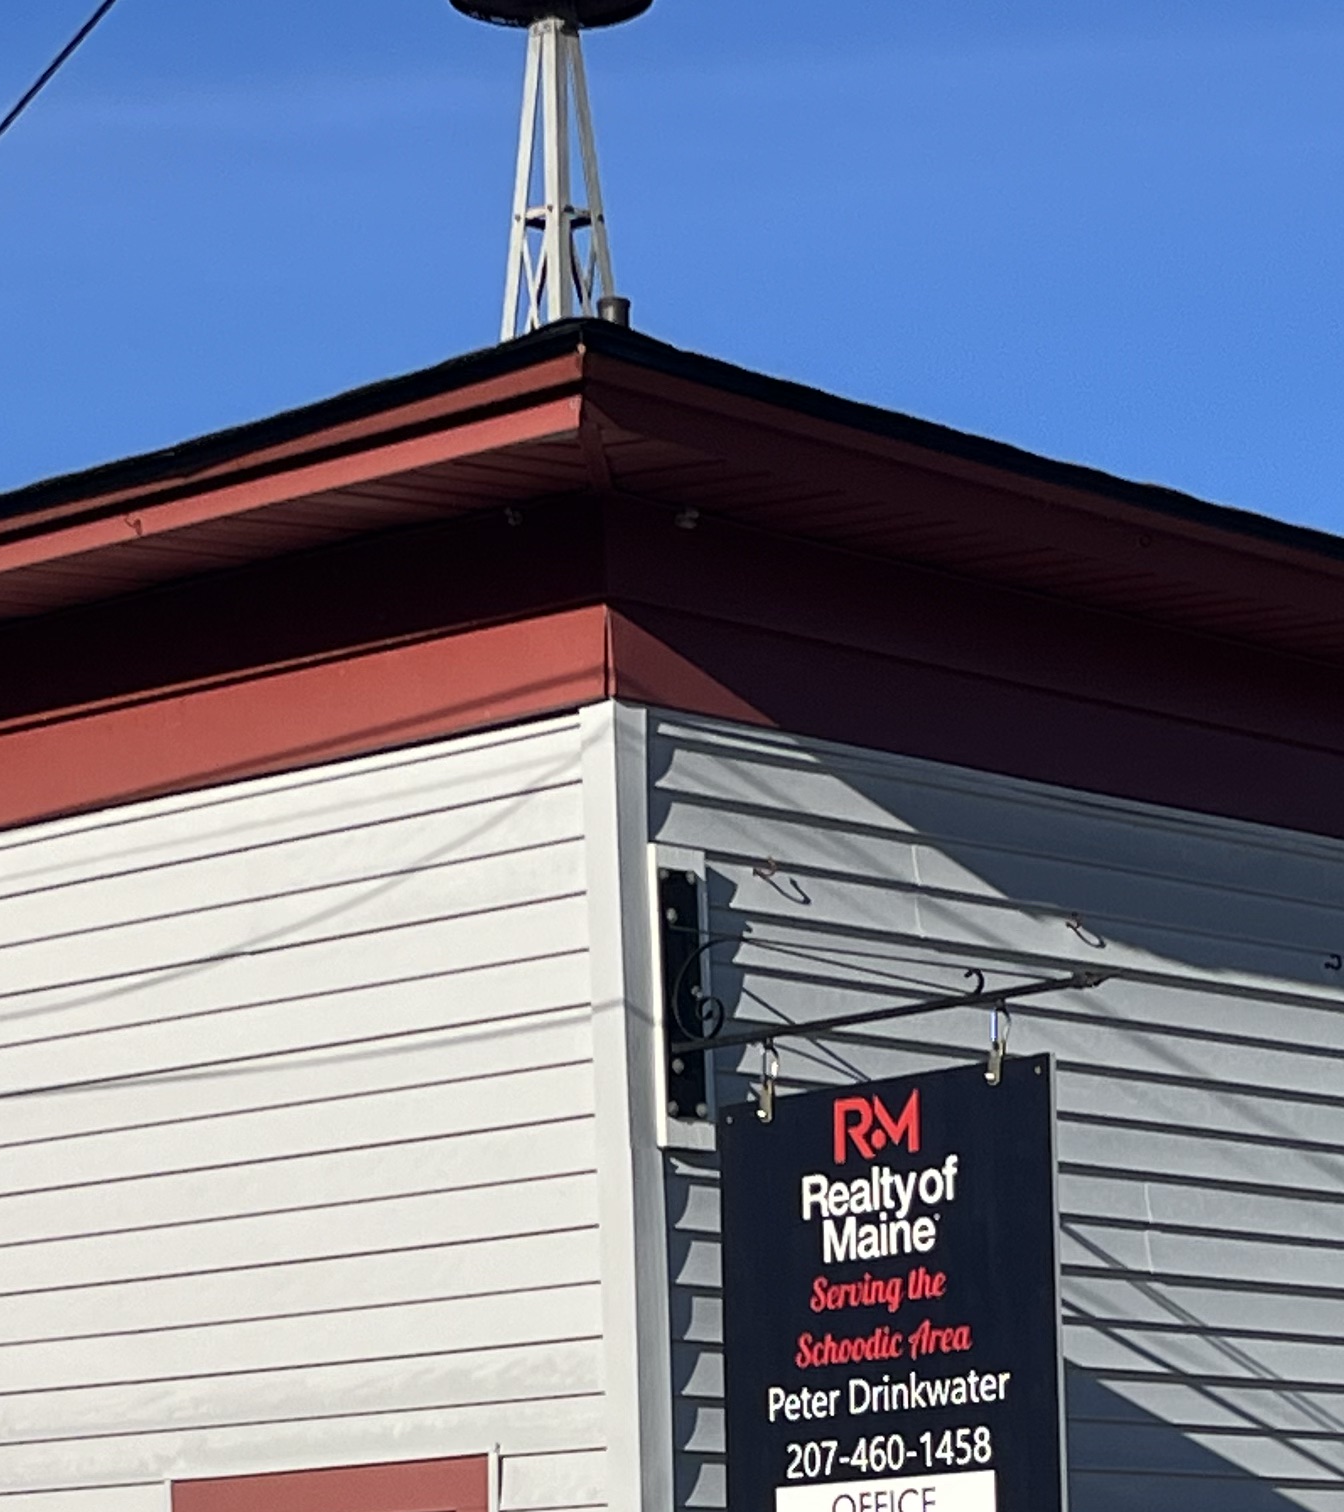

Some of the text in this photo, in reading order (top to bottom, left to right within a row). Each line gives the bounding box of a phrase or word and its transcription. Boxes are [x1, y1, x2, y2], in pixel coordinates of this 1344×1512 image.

[801, 1154, 959, 1221] Realty of
[822, 1211, 937, 1264] Maine
[810, 1266, 947, 1313] Serving the
[795, 1318, 972, 1369] Schoodic Area
[767, 1369, 1011, 1422] Peter Drinkwater
[786, 1426, 992, 1479] 207-460-1458
